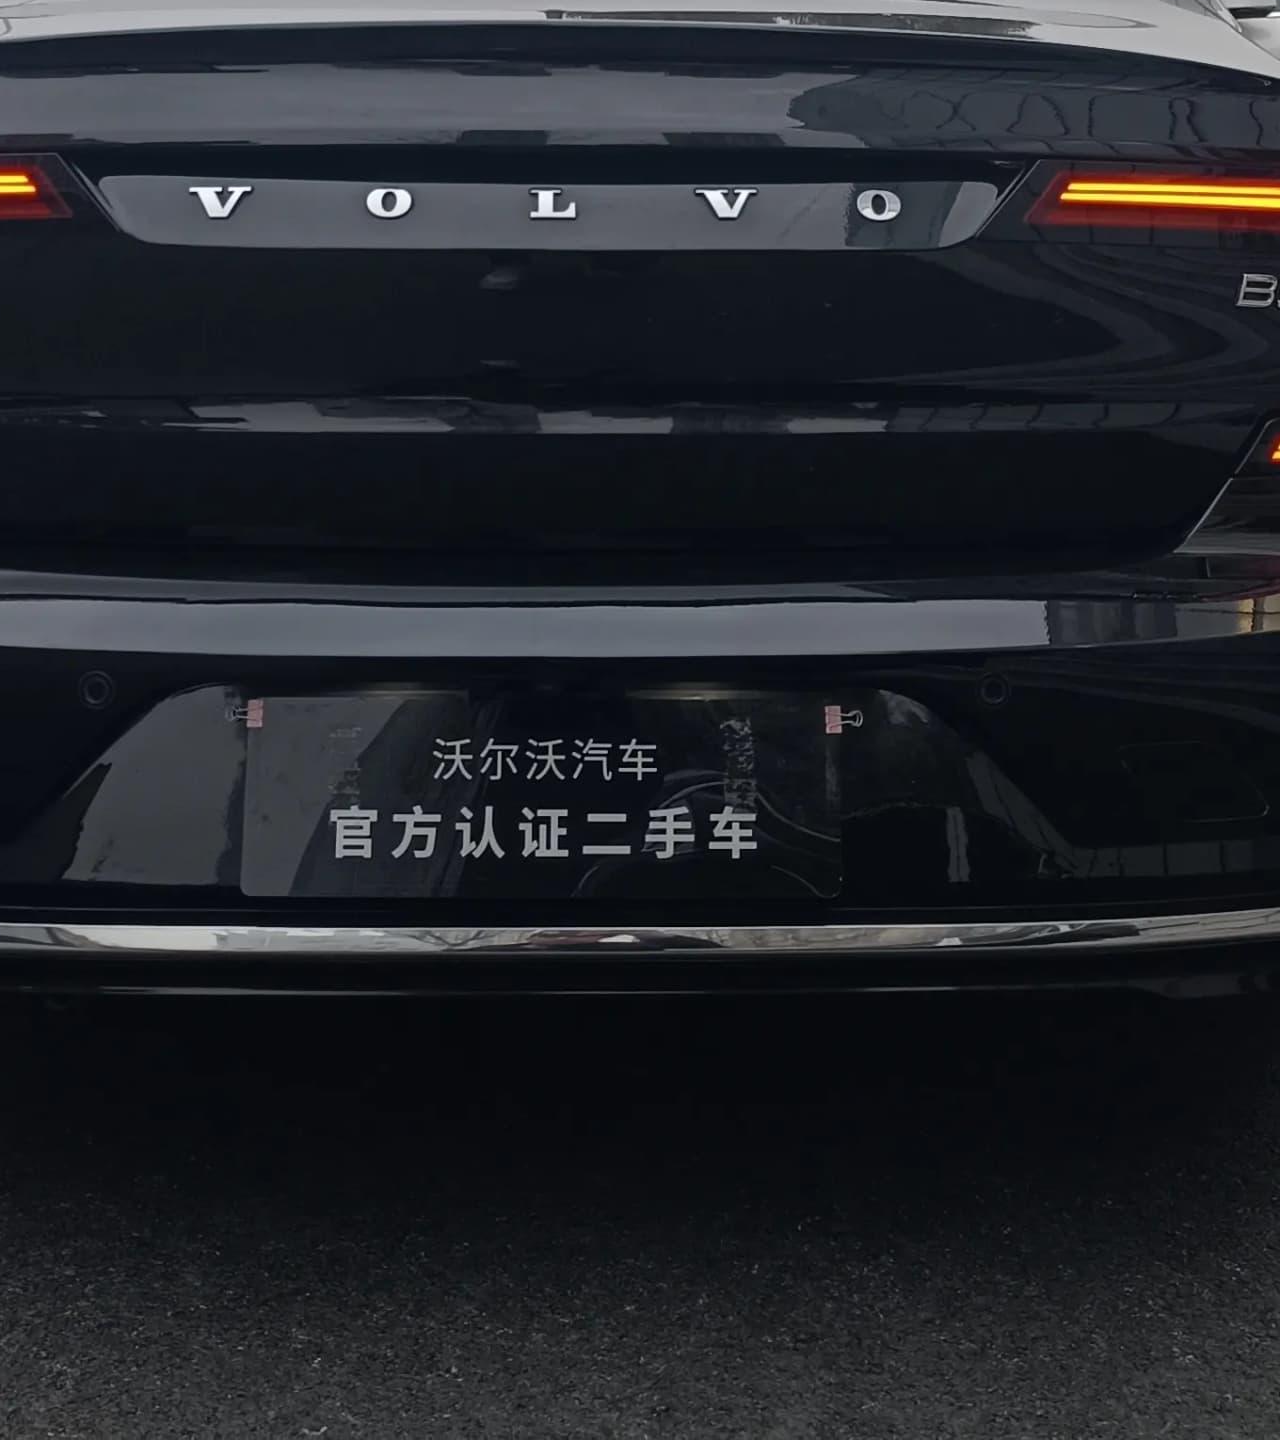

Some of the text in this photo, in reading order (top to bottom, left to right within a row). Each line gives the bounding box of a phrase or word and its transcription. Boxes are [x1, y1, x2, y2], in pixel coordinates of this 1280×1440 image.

[188, 185, 902, 222] VOLVO
[432, 737, 659, 783] 沃尔沃汽车
[329, 806, 761, 861] 官方认证二手车
